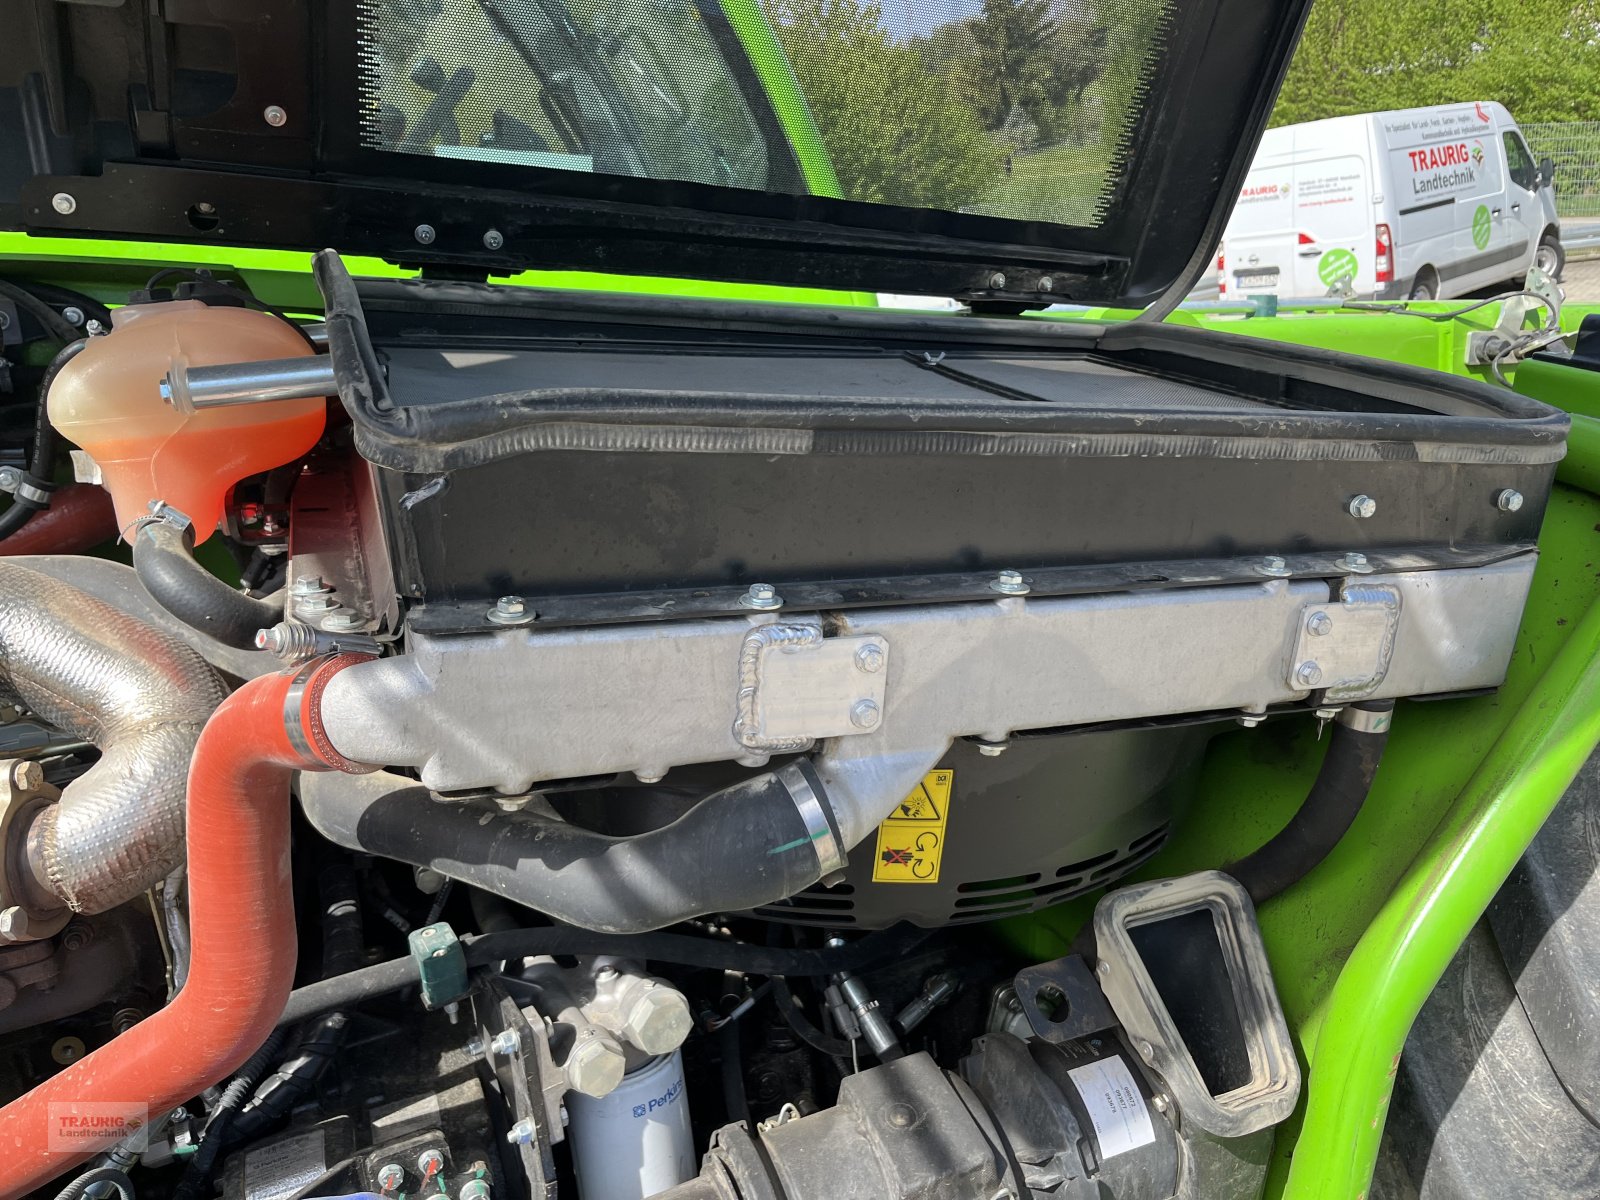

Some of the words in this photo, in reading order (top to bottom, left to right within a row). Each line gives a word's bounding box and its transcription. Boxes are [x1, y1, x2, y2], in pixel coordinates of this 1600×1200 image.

[1408, 143, 1469, 172] TRAURIG
[1241, 184, 1278, 197] RAURIG
[1412, 166, 1476, 194] Landtechnik
